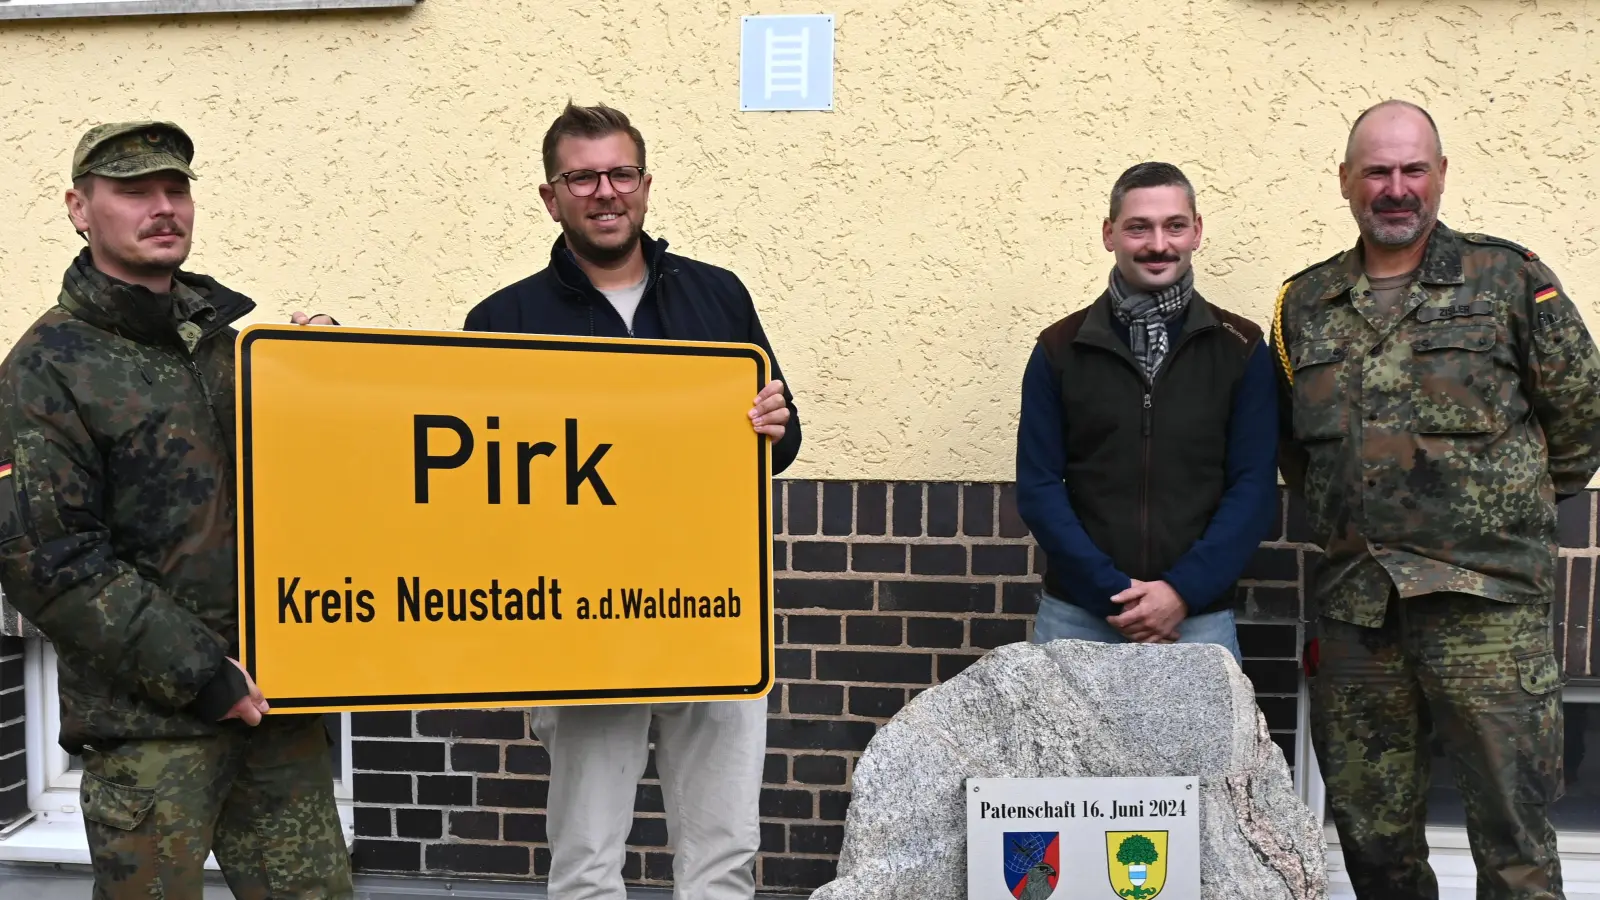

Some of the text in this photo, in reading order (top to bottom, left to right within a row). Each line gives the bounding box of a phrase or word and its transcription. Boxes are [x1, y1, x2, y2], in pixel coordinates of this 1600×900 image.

[413, 414, 617, 505] Pirk
[278, 576, 375, 624] Kreis
[398, 576, 563, 623] Neustadt
[980, 799, 1187, 820] Patenschaft 16. Juni 2024
